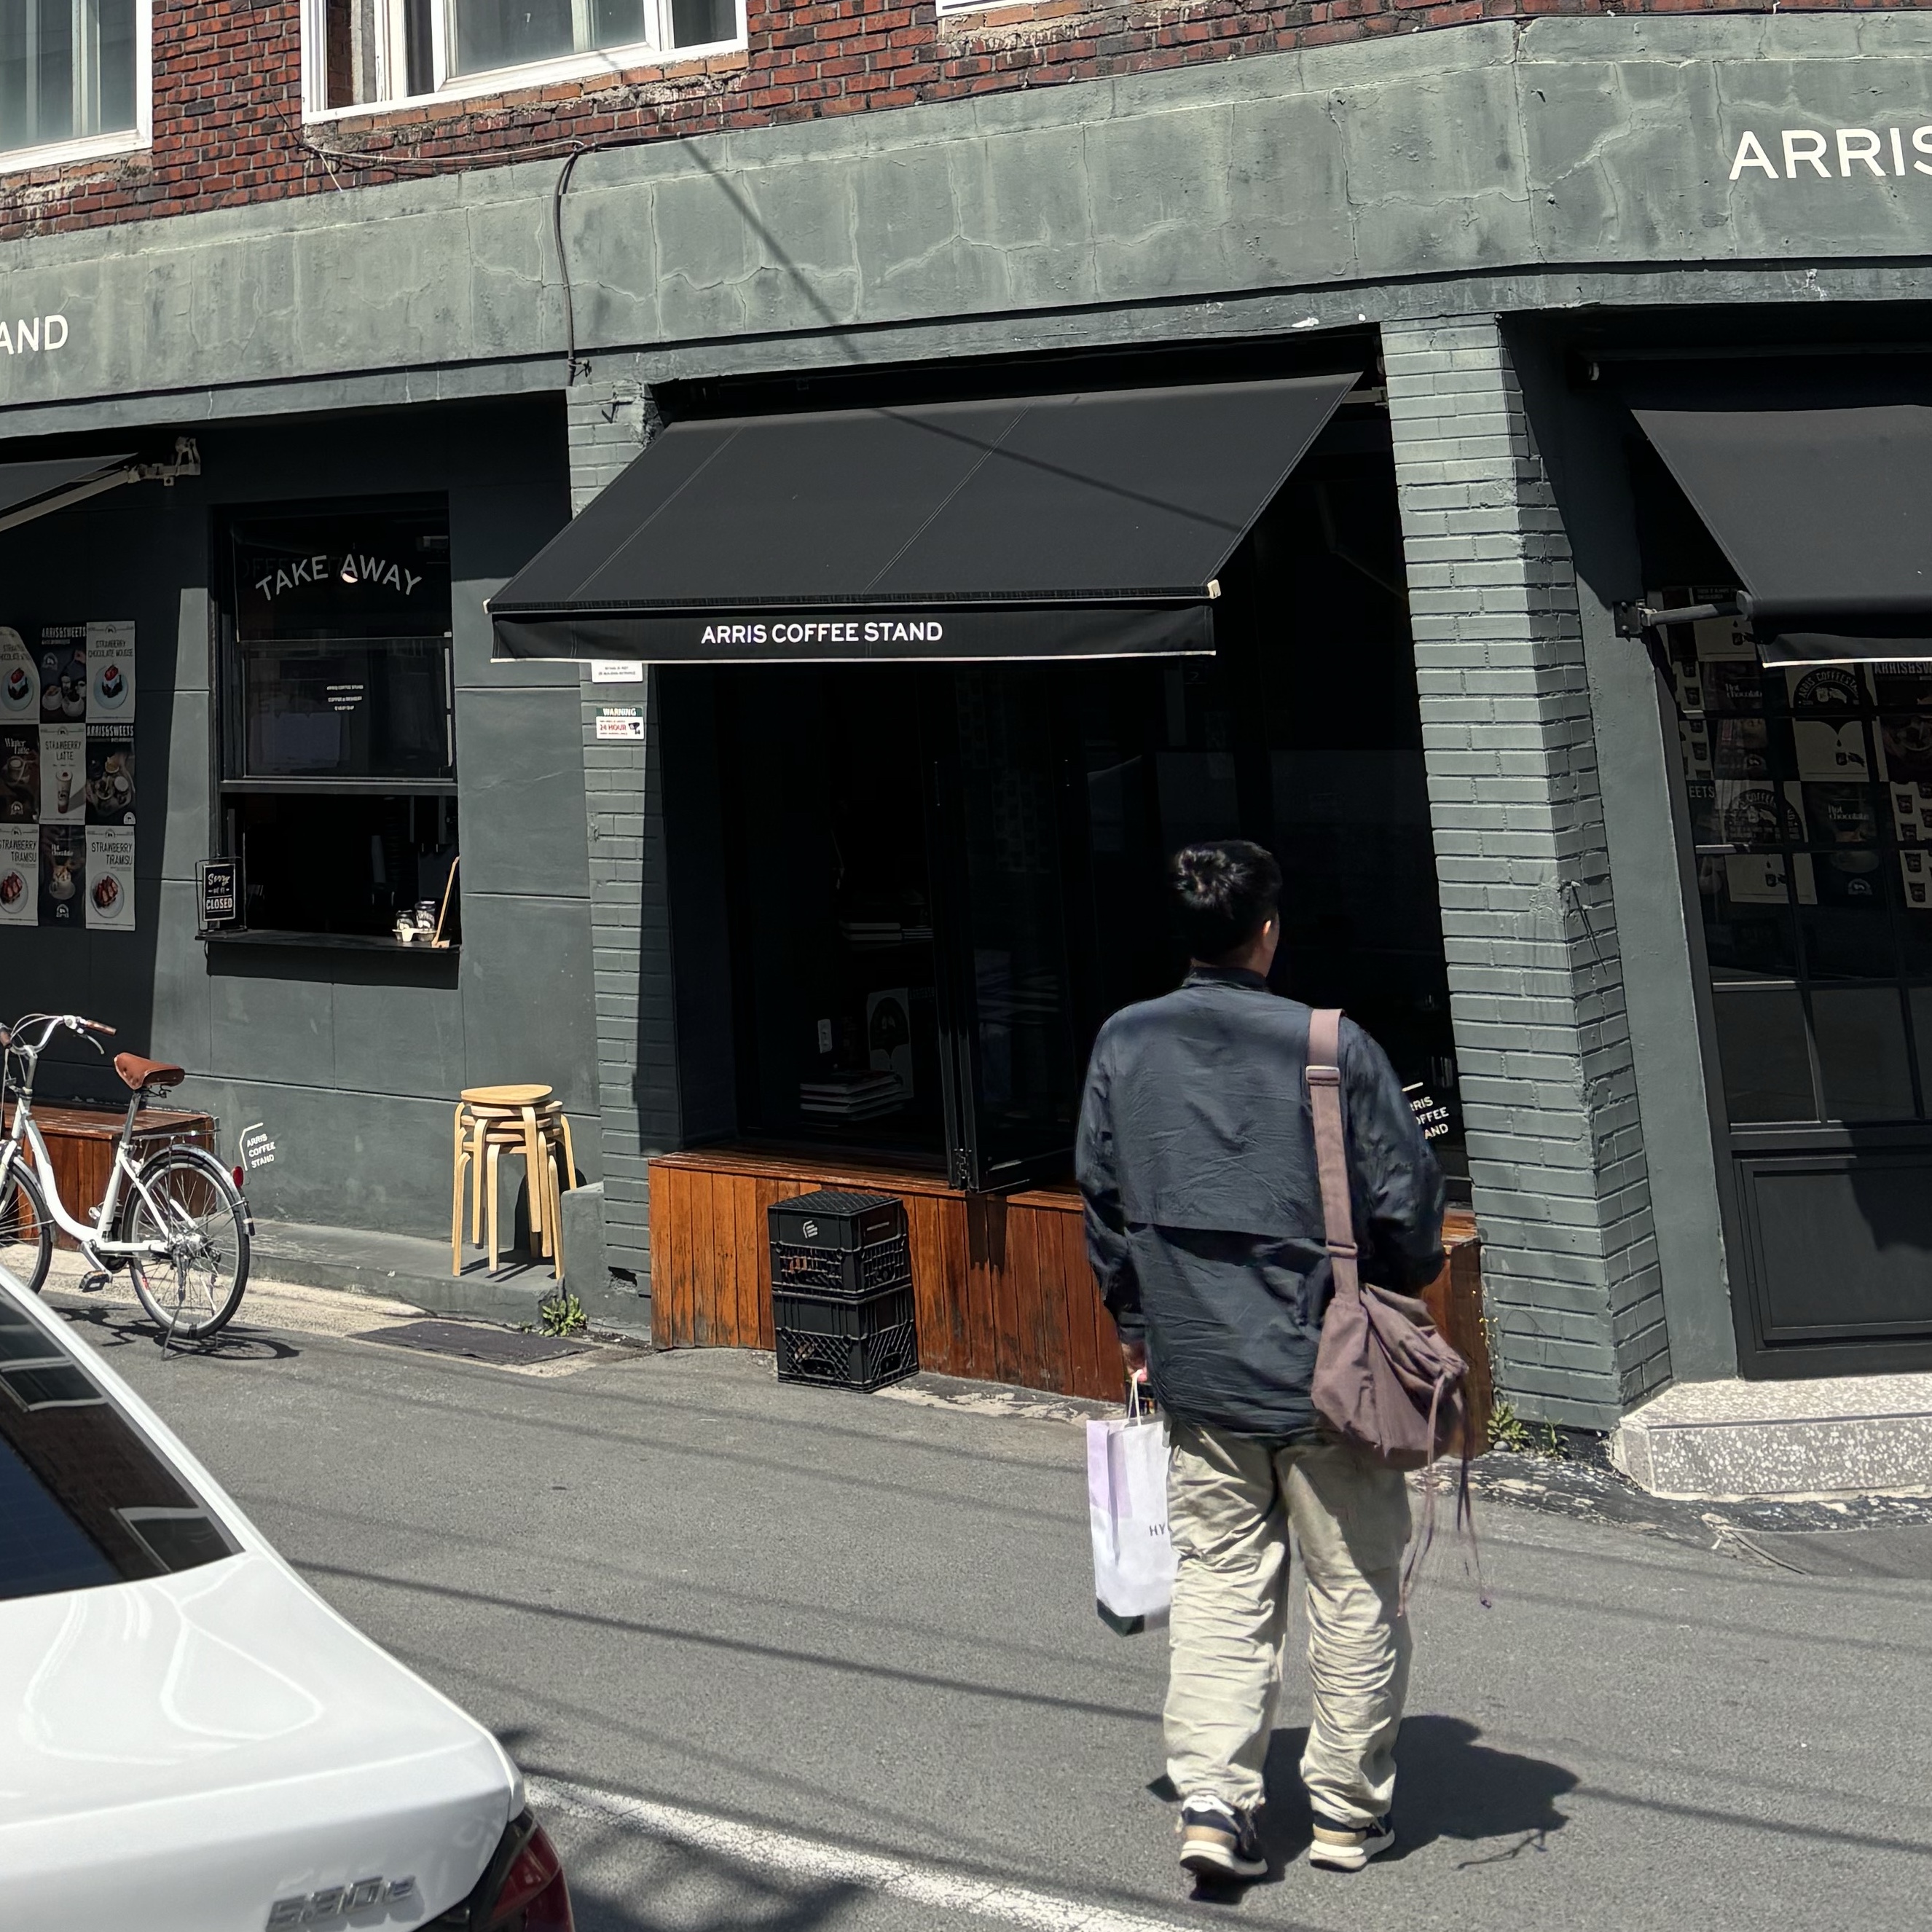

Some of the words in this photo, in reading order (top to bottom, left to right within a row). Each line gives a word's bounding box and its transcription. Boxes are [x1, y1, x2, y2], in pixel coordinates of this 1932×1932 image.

[0, 314, 68, 355] AND
[255, 554, 329, 601] TAKE
[341, 553, 422, 596] AWAY
[701, 624, 767, 644] ARRIS
[771, 622, 859, 643] COFFEE
[864, 621, 943, 642] STAND
[602, 707, 637, 716] WARNING
[45, 741, 81, 750] STRAWBERRY
[56, 750, 74, 761] LATTE
[91, 841, 133, 853] STRAWBERRY
[206, 897, 232, 911] CLOSED
[1424, 1123, 1449, 1140] AND
[246, 1133, 268, 1148] ARRIS
[248, 1141, 276, 1158] COFFEE
[251, 1153, 275, 1169] STAND
[1149, 1522, 1166, 1537] HY
